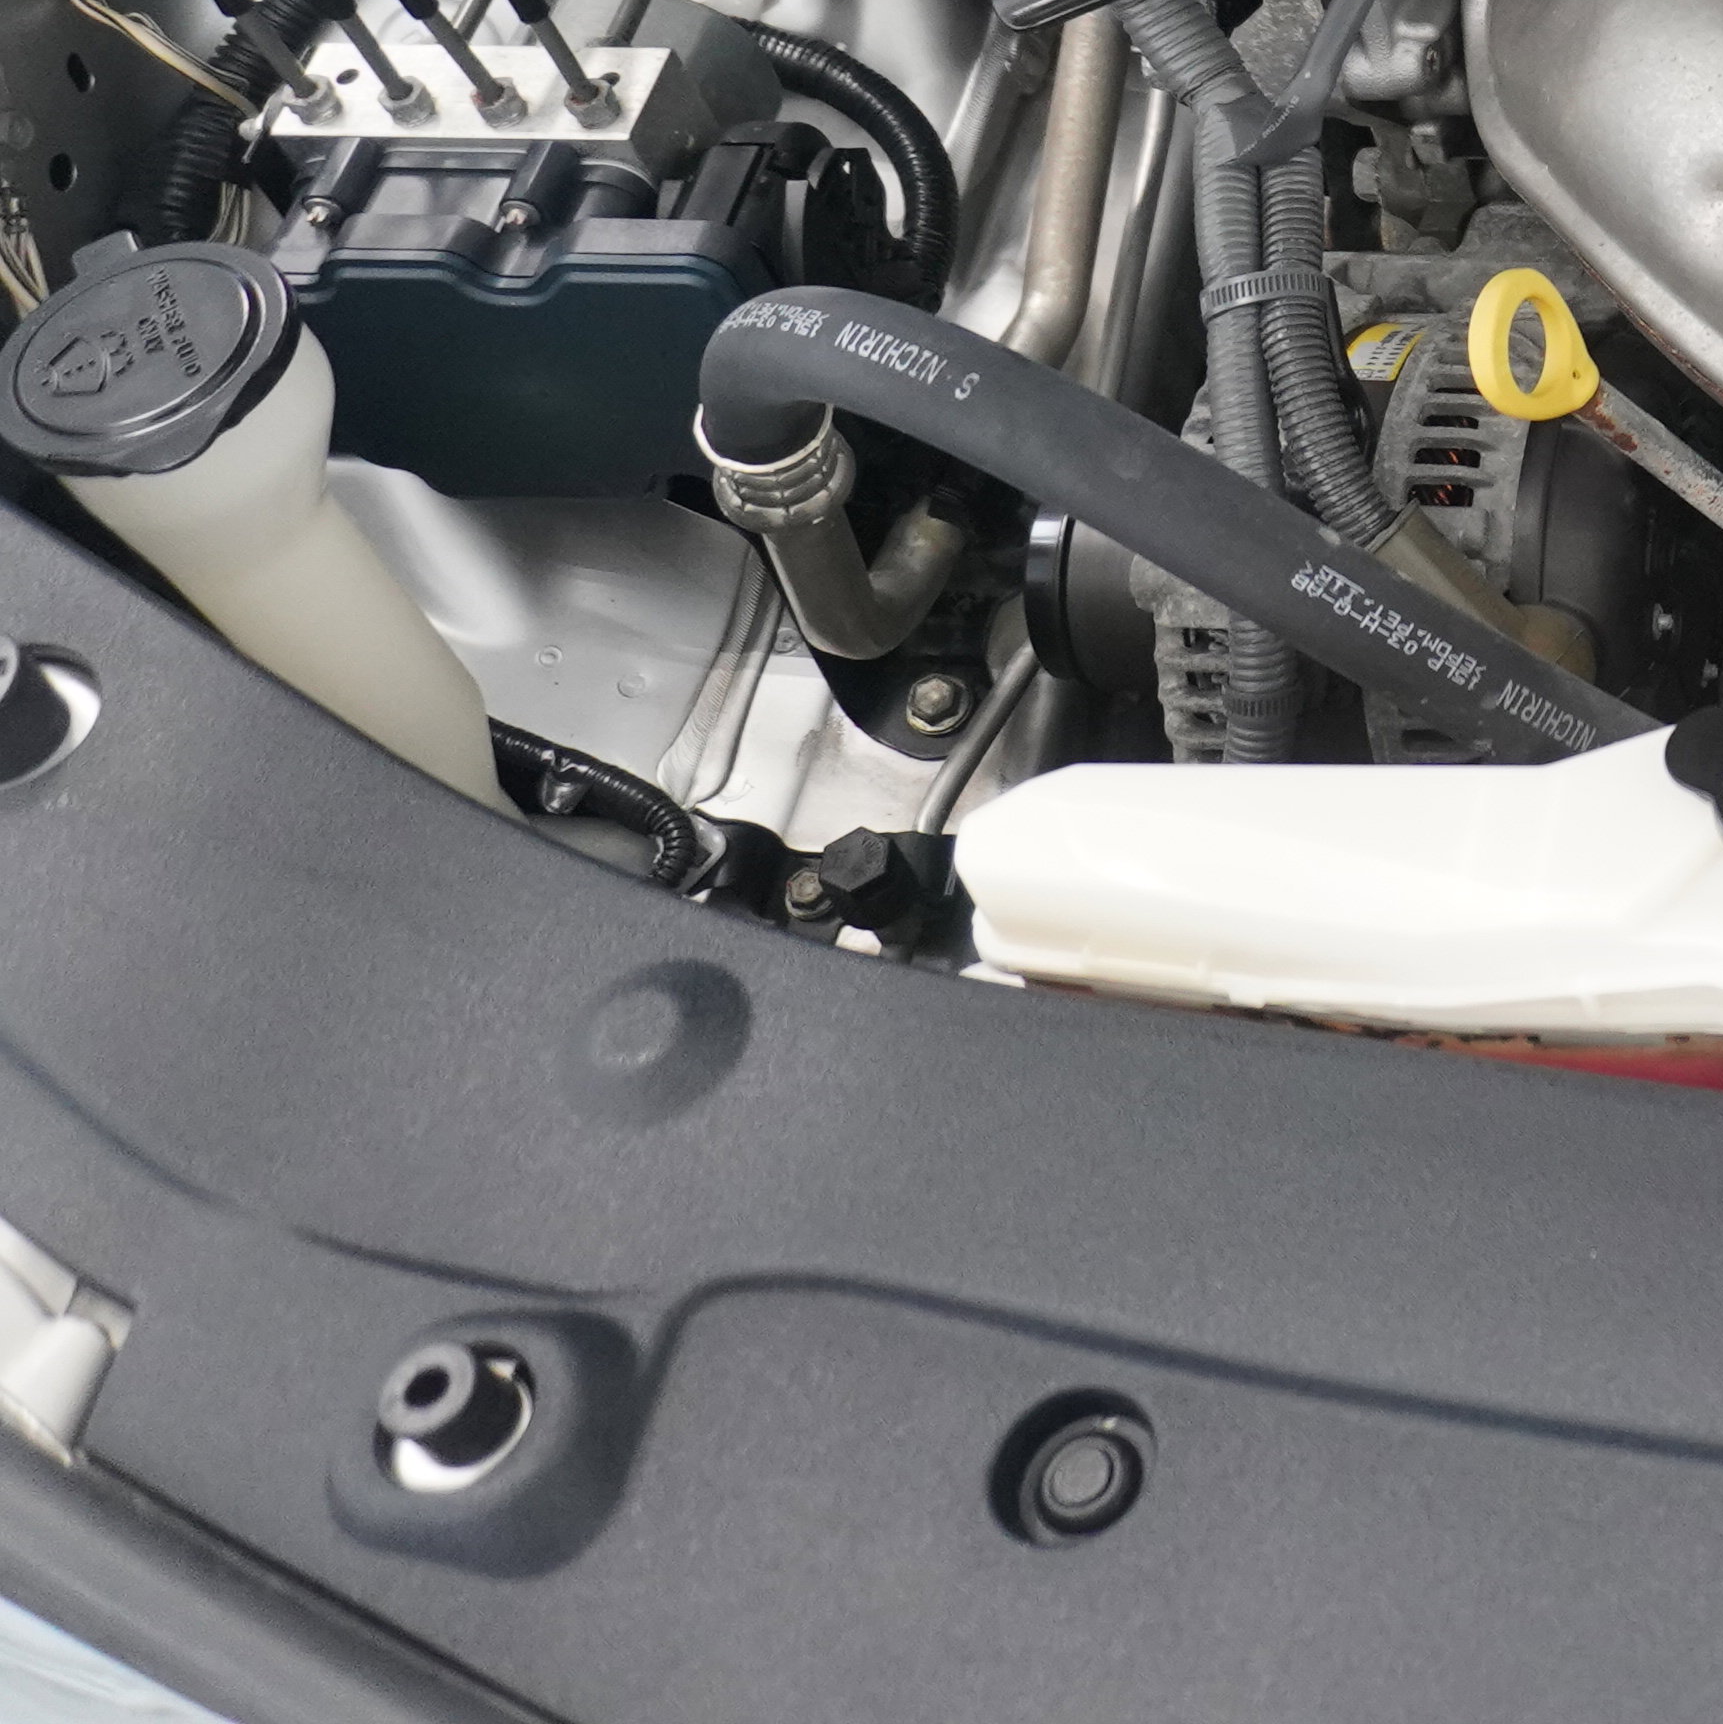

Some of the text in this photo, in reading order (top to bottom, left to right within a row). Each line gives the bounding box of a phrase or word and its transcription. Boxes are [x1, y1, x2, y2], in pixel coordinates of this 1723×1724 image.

[137, 314, 165, 355] ONLY
[145, 264, 202, 378] WASHER FLUID
[834, 321, 946, 388] NICHIRIN
[953, 369, 982, 402] S
[1494, 678, 1596, 754] NICHIRIN
